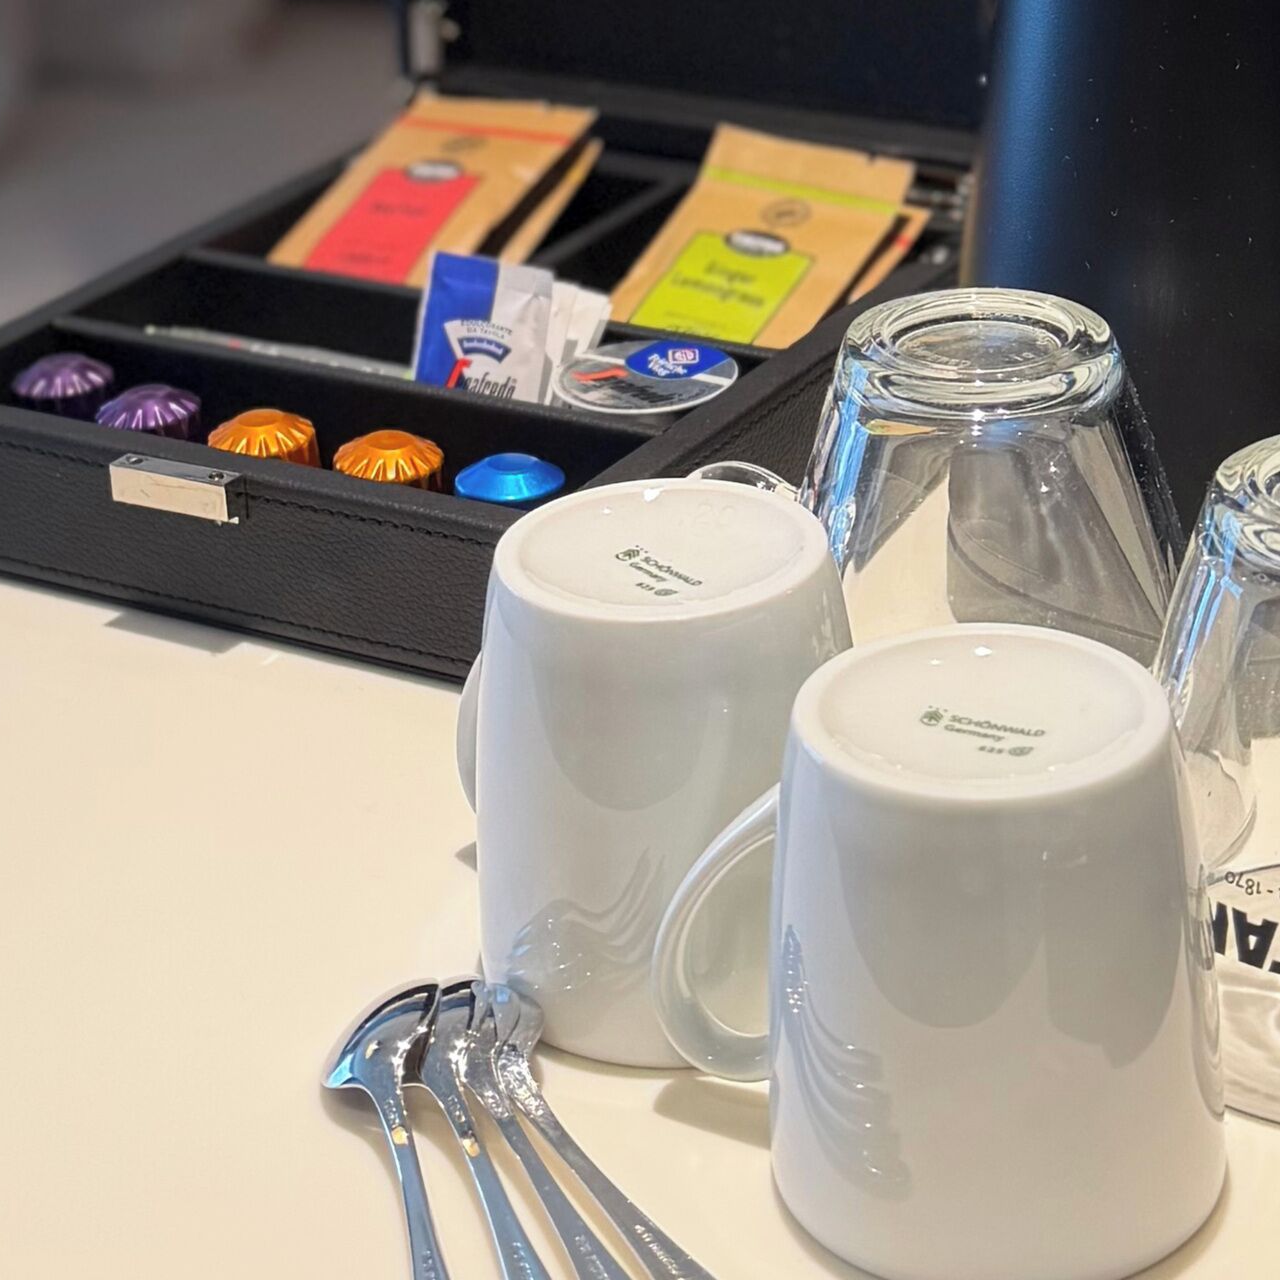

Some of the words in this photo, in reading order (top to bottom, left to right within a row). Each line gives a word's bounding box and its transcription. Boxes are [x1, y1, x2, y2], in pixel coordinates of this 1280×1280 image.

[943, 723, 1006, 742] Germany
[949, 714, 1046, 737] SCHÖNWALD
[1224, 871, 1262, 896] 1870
